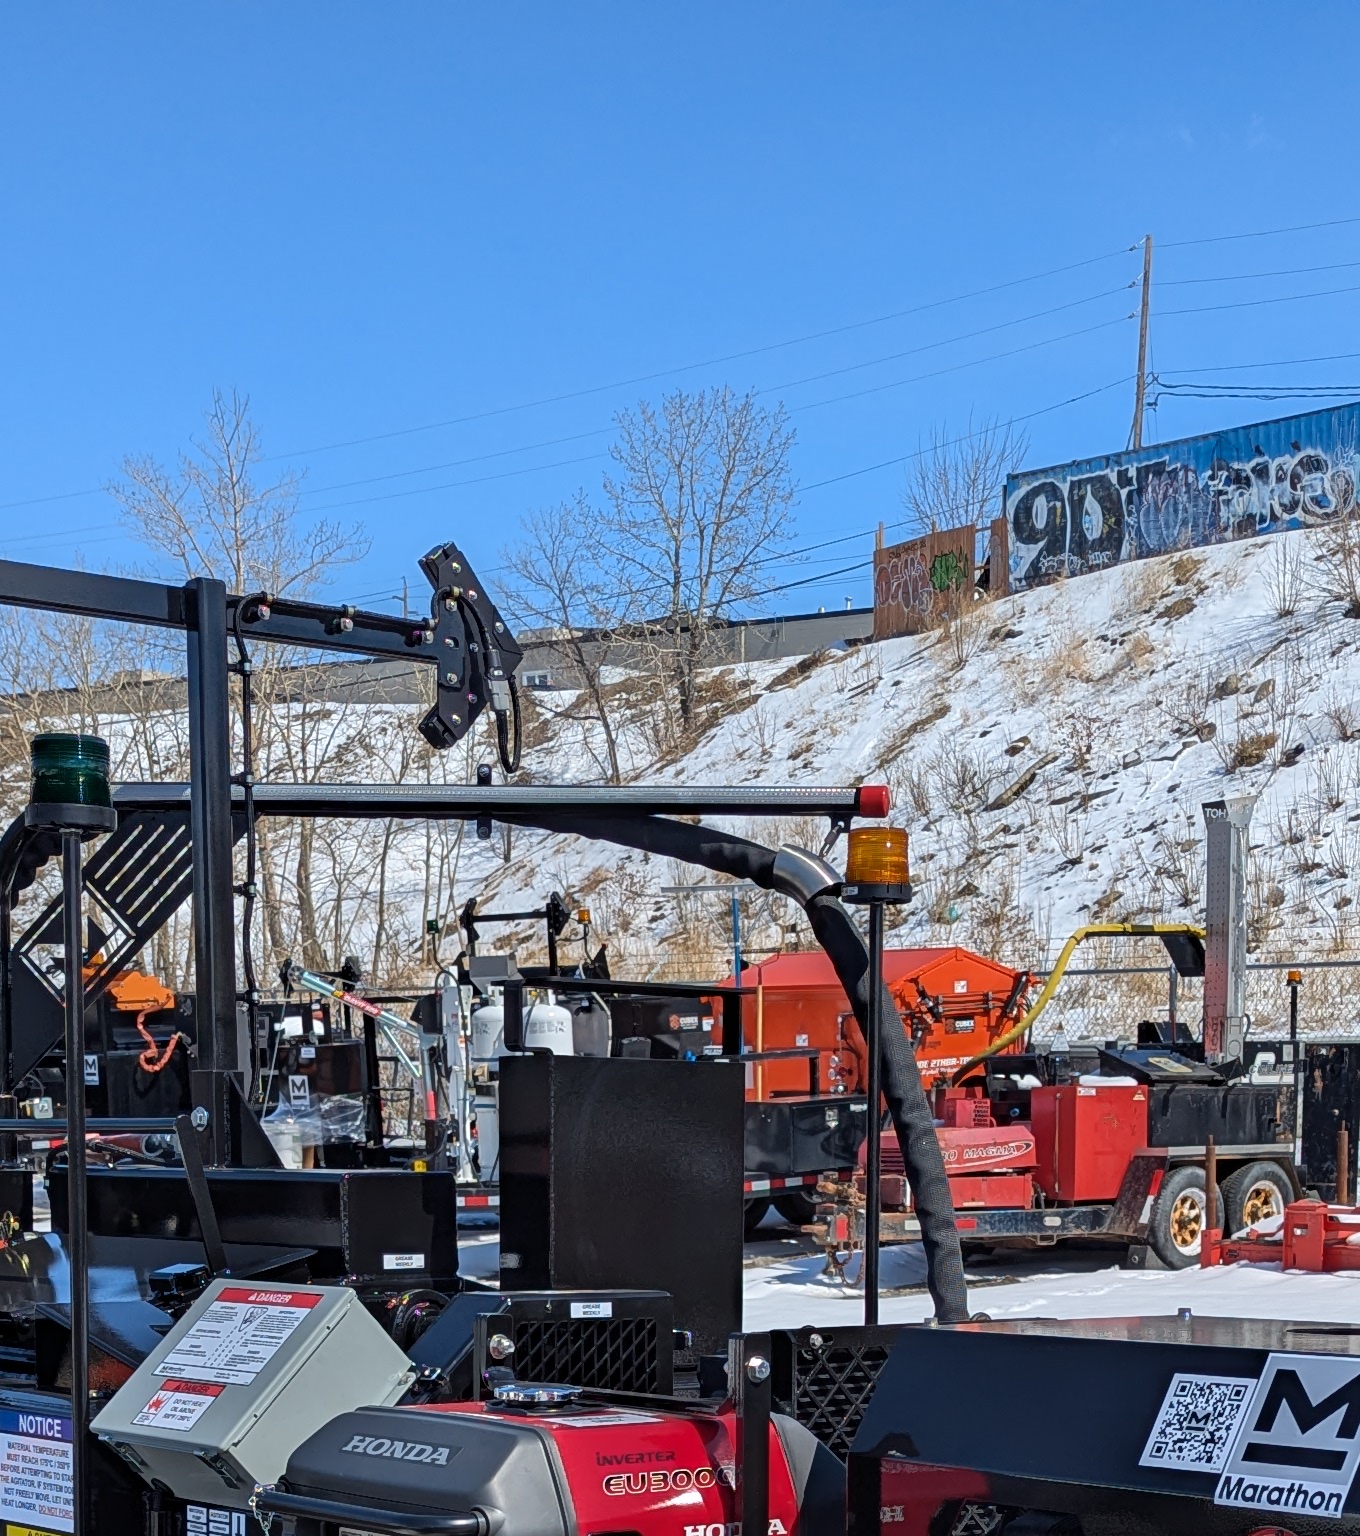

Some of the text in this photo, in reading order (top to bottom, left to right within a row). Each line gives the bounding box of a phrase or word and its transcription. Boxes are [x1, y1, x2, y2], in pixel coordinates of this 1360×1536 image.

[291, 1079, 306, 1093] M
[964, 1145, 1016, 1159] MAGMA
[256, 1293, 292, 1304] DANGER
[182, 1383, 210, 1394] DANGER
[19, 1414, 62, 1438] NOTICE
[7, 1441, 70, 1458] MATERIAL TEMPERATURE
[342, 1435, 451, 1466] HONDA
[6, 1452, 20, 1462] MUST
[21, 1455, 38, 1465] REACH
[1, 1463, 73, 1482] BEFORE ATTEMPTING TO STA
[603, 1465, 742, 1496] EU3000
[0, 1475, 10, 1484] THE
[37, 1480, 41, 1489] IF
[42, 1482, 63, 1492] SYSTEM
[4, 1487, 14, 1496] NOT
[16, 1489, 34, 1499] FREELY
[52, 1495, 61, 1504] LET
[1218, 1476, 1342, 1513] Marathon
[1, 1498, 14, 1507] HEAT
[59, 1509, 72, 1518] FORC
